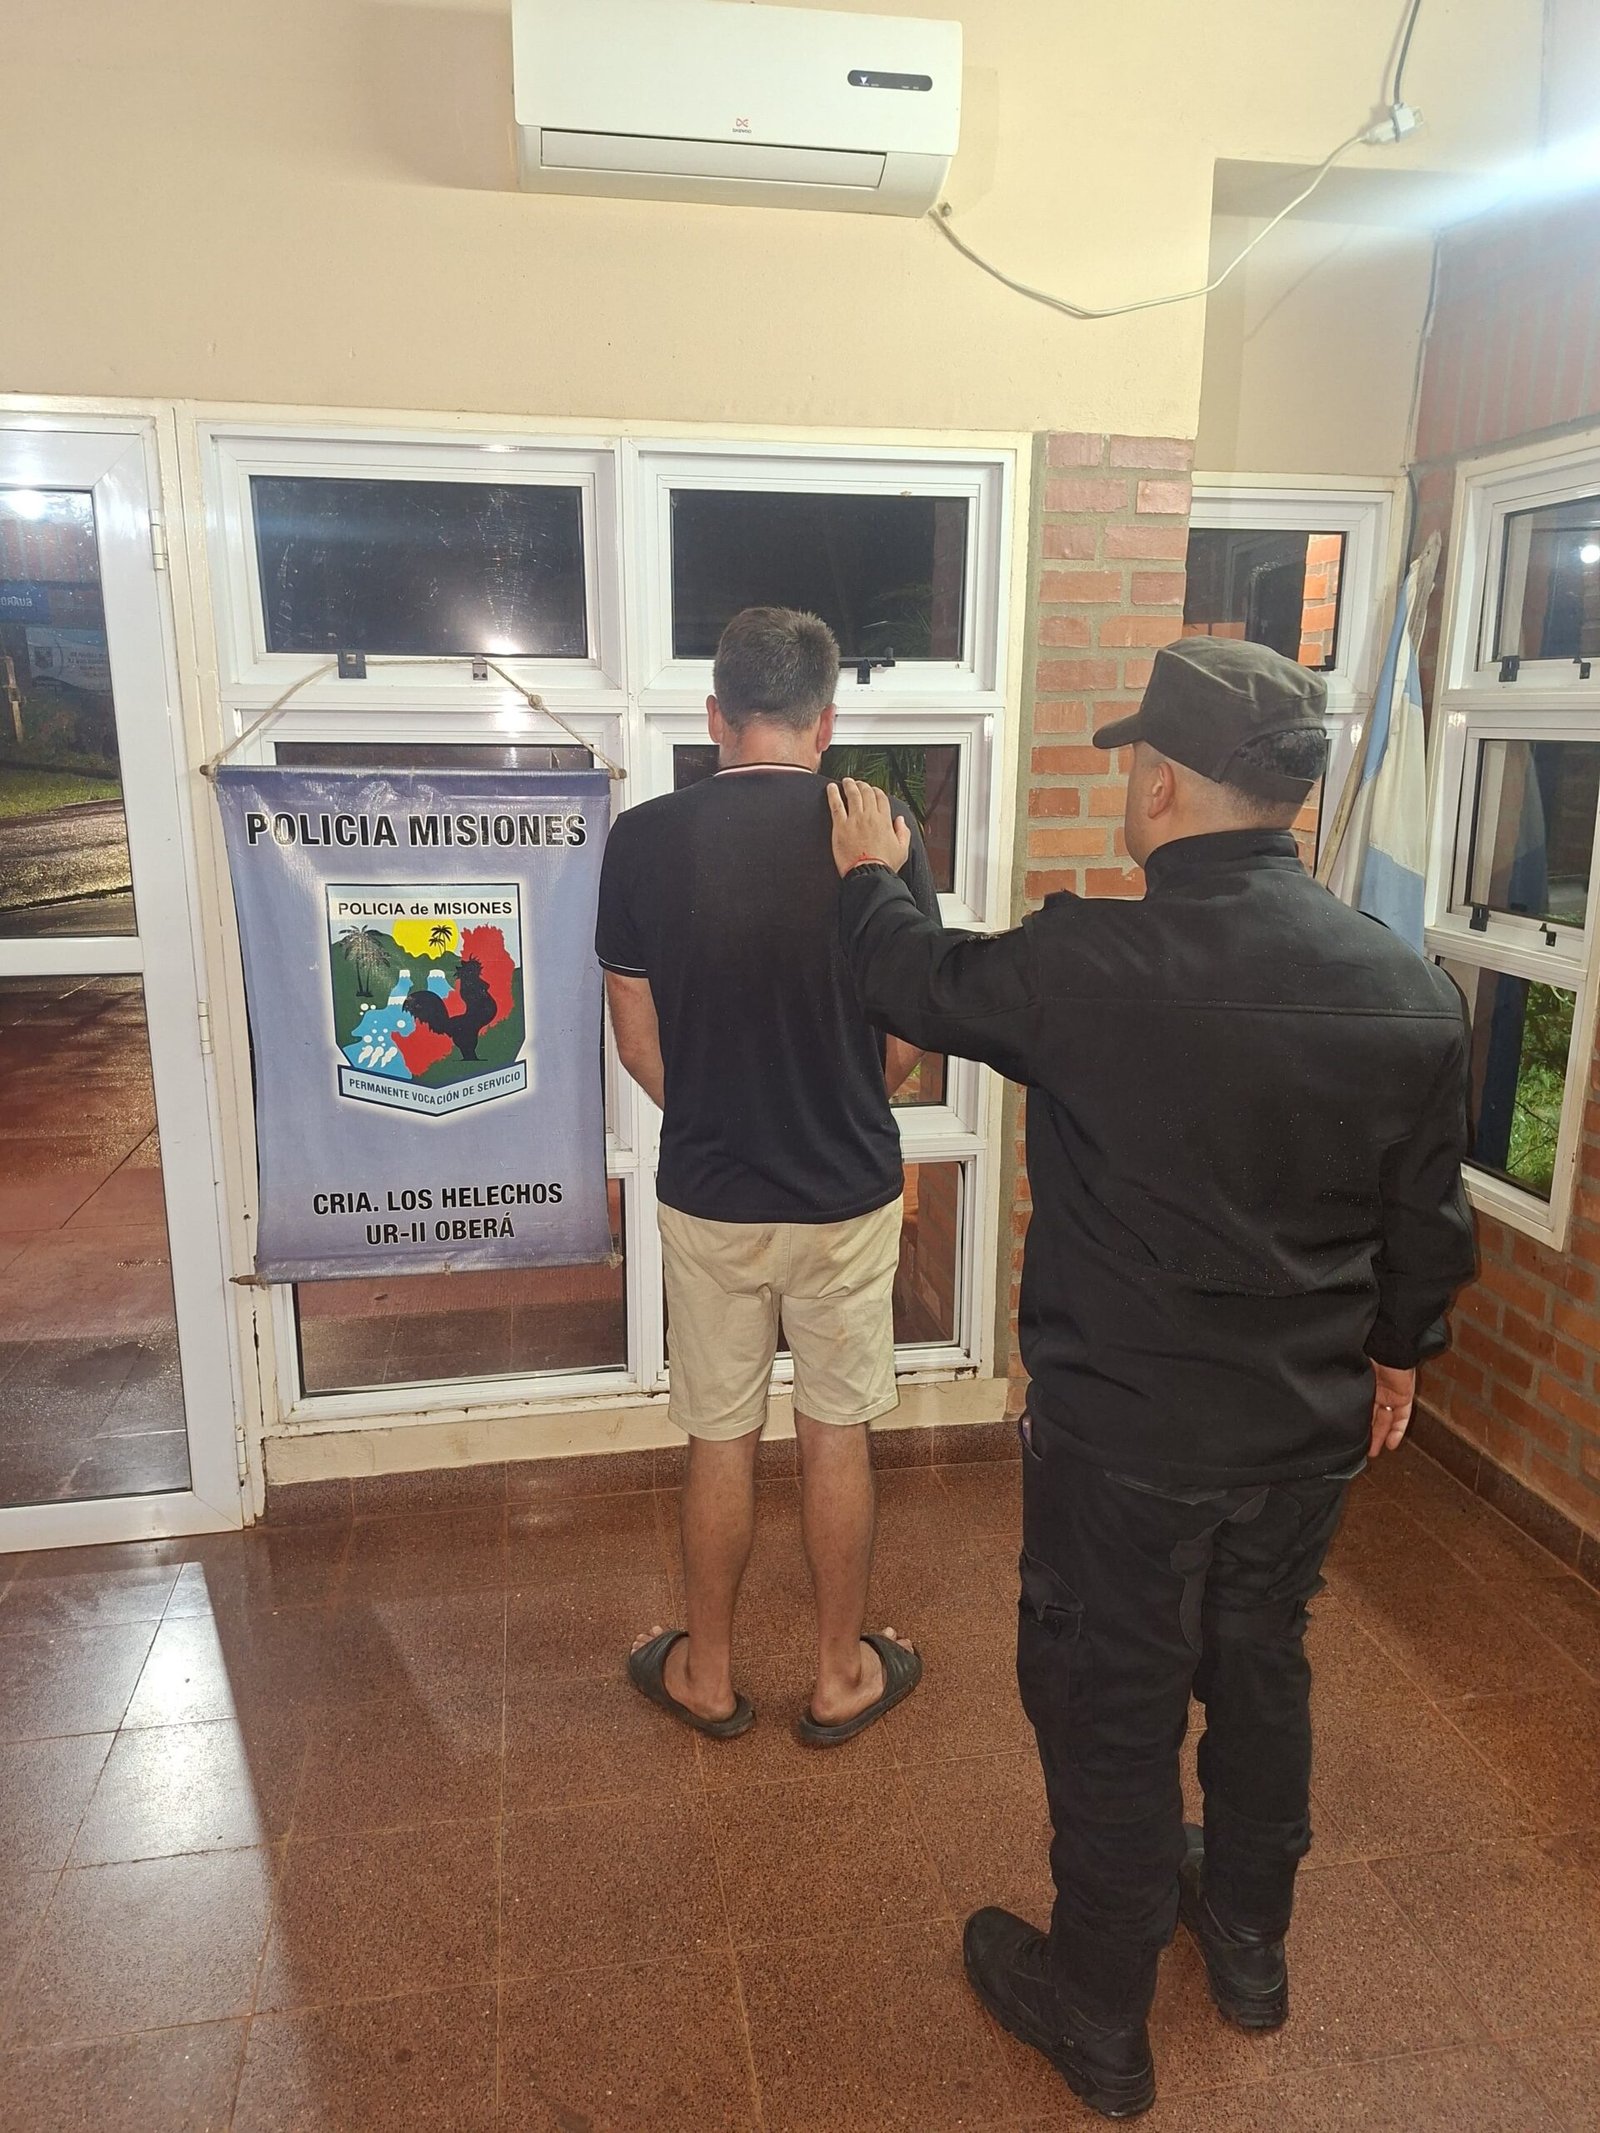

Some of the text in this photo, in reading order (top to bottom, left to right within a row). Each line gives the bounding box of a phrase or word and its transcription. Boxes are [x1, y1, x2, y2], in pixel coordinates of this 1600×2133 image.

[247, 813, 587, 847] POLICIA MISIONES
[338, 902, 512, 915] POLICIA de MISIONES
[350, 1071, 521, 1105] PERMANENTE VOCACIÓN DE SERVICIO
[313, 1183, 563, 1215] CRIA. LOS HELECHOS
[366, 1212, 515, 1245] UR-II OBERÁ
